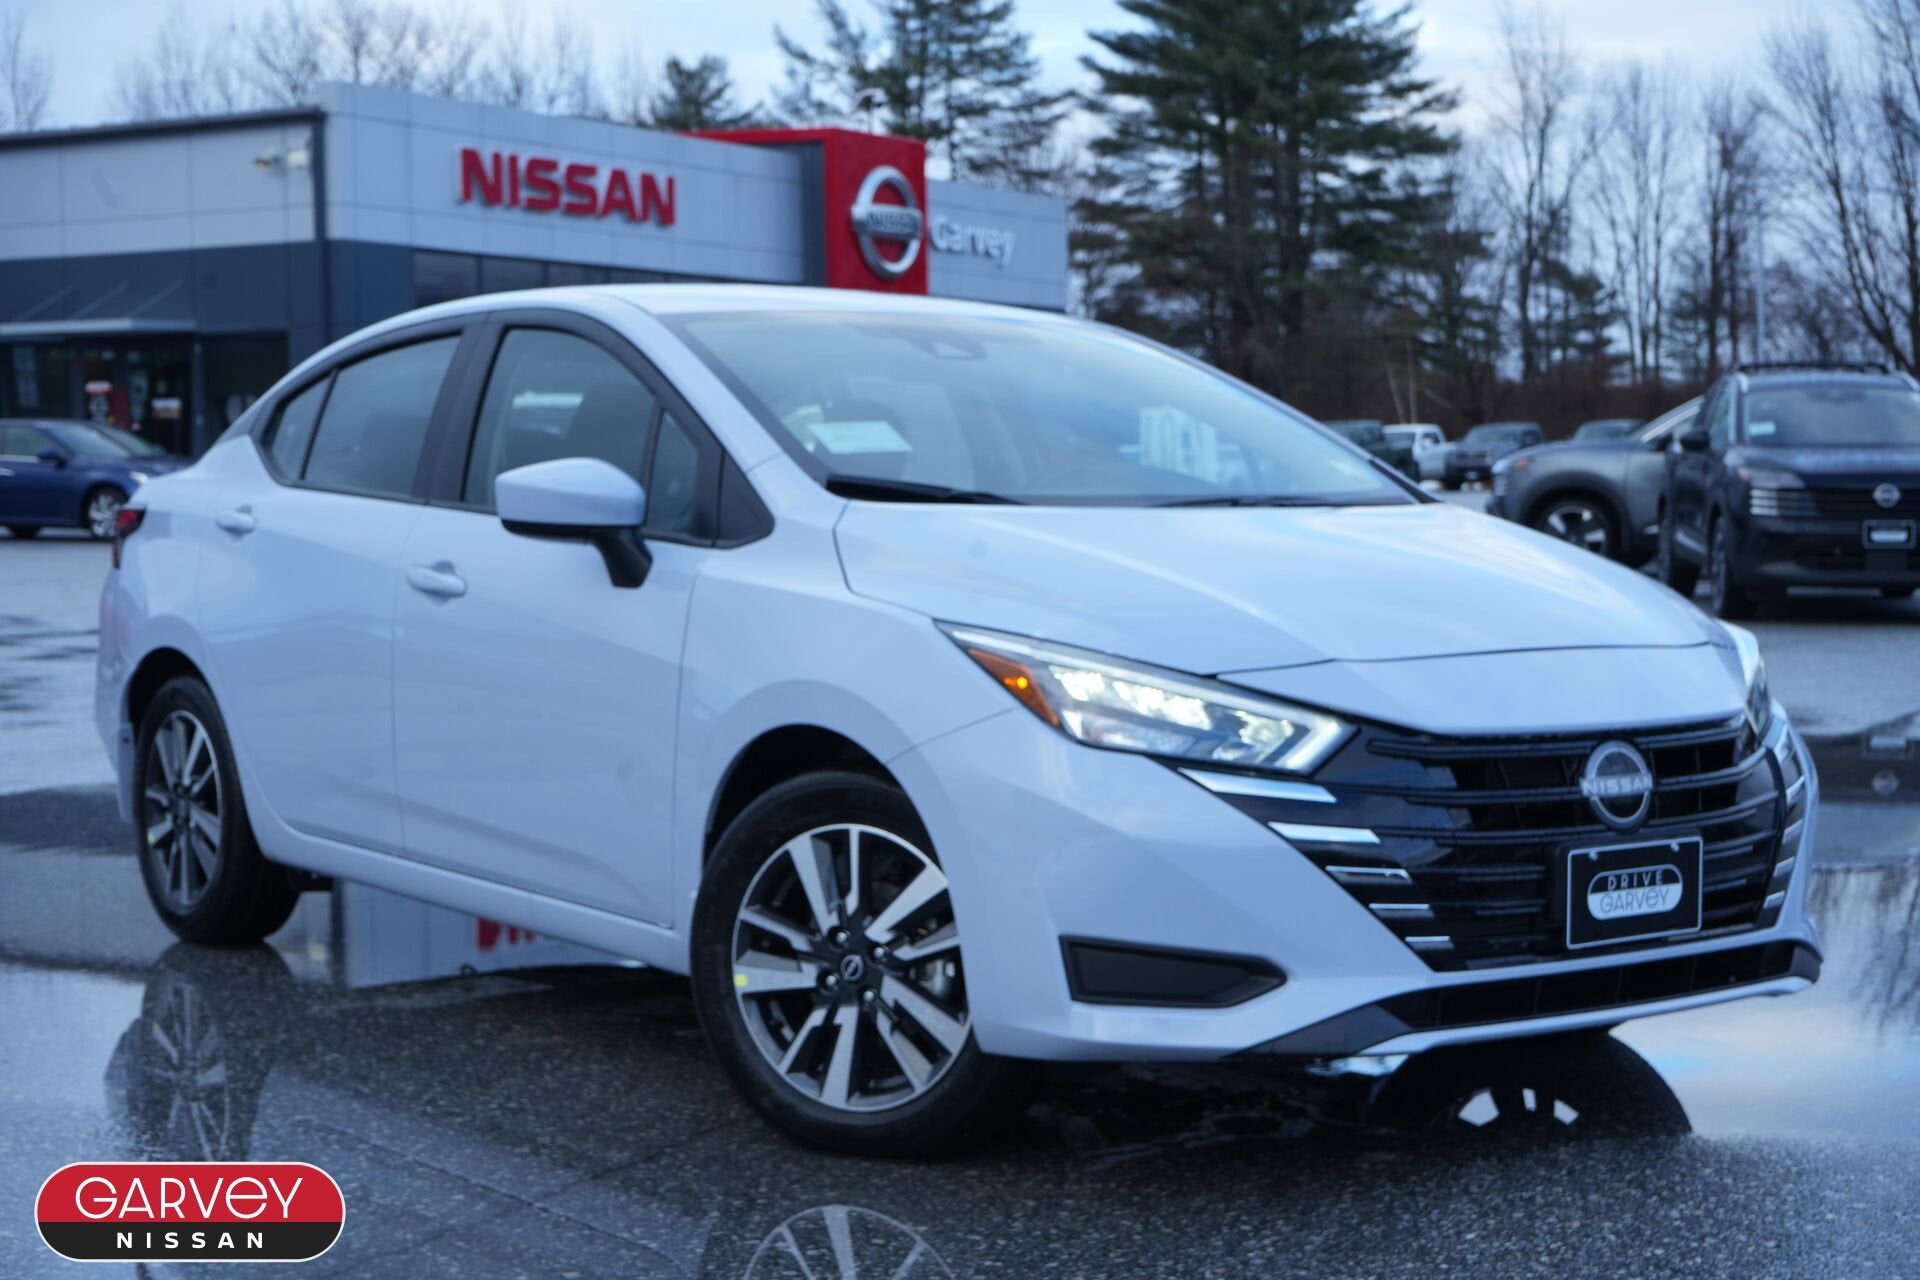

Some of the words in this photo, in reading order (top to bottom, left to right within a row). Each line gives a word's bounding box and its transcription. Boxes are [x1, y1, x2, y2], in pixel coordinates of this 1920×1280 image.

[460, 148, 676, 227] NISSAN
[1581, 774, 1653, 796] NISSAN
[1607, 870, 1664, 891] DRIVE
